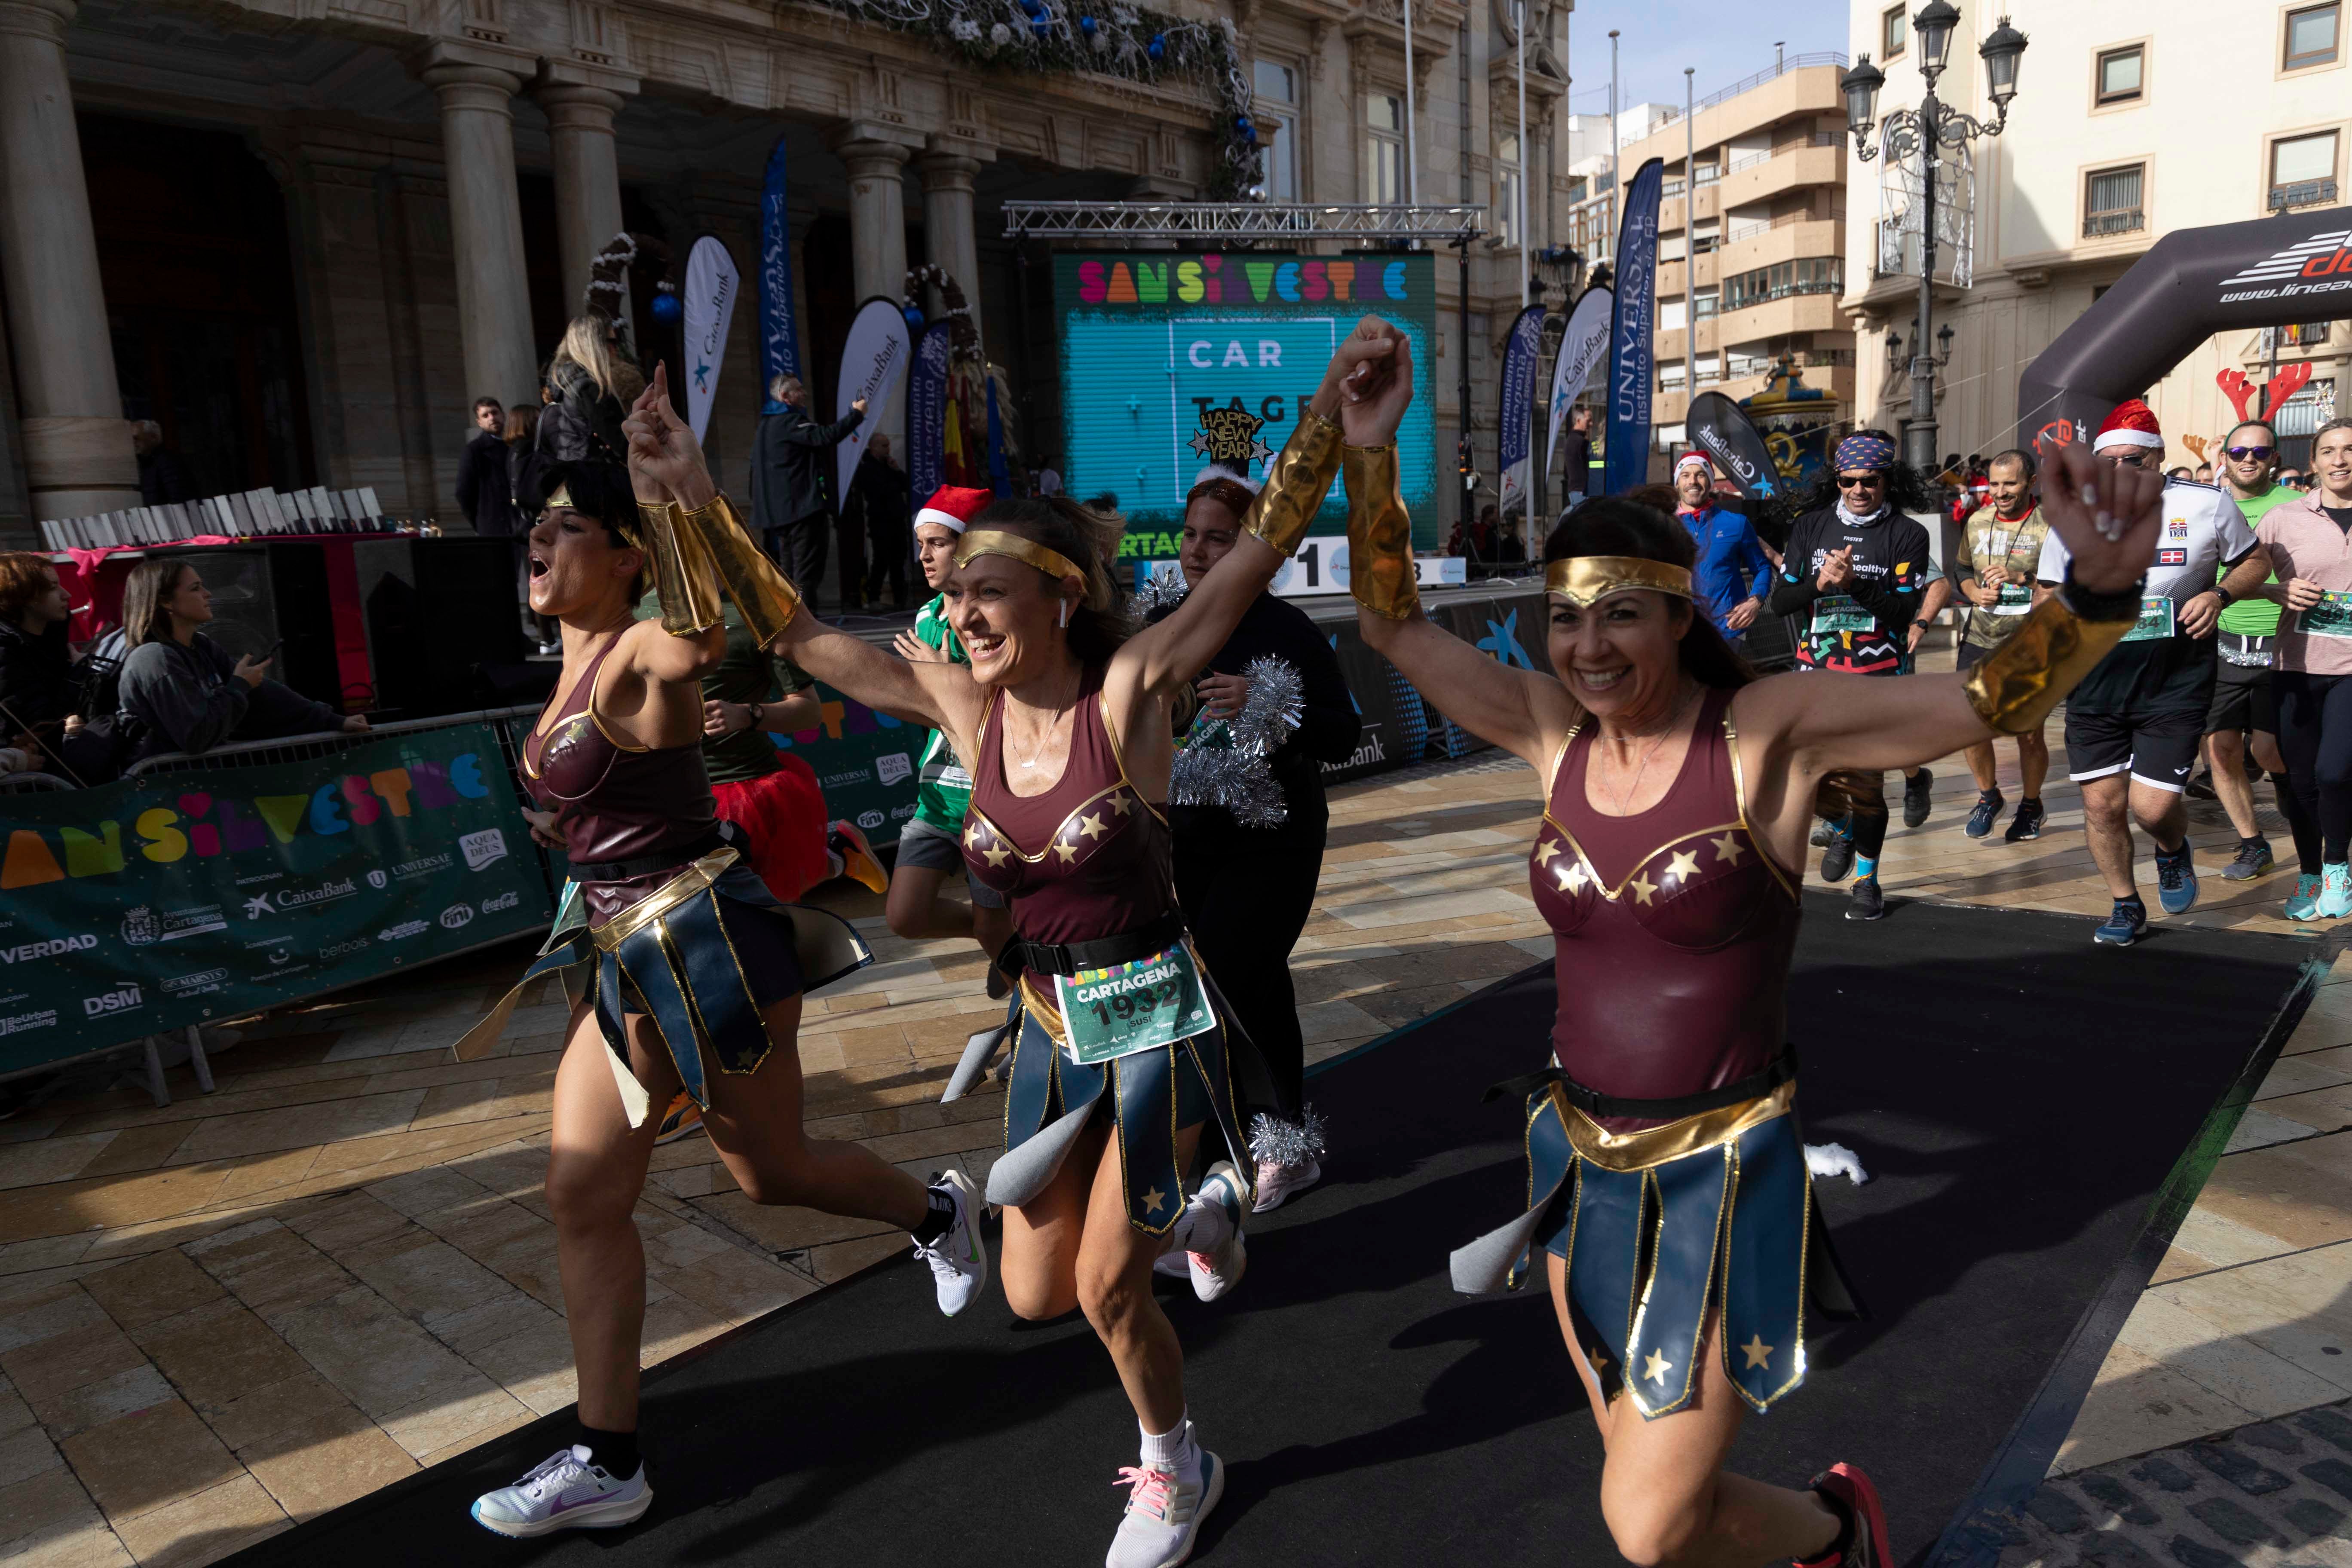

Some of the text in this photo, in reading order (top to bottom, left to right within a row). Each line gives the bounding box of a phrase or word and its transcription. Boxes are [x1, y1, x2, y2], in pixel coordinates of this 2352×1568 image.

[1644, 215, 1656, 239] FP
[2220, 280, 2352, 303] www.linea
[1636, 273, 1651, 348] Superior
[1188, 339, 1283, 368] CAR
[855, 334, 899, 402] CaixaBank
[1635, 353, 1648, 425] Instituto
[1501, 349, 1515, 457] Ayuntamiento
[1508, 354, 1527, 459] Cartagena
[1200, 410, 1263, 431] HAPPY
[911, 376, 922, 495] Ayuntamiento
[922, 379, 936, 496] Cartagena
[1209, 425, 1252, 443] NEW
[1297, 544, 1319, 586] 1
[1822, 606, 1867, 614] CARTAGENA
[881, 756, 907, 766] AQUA
[882, 764, 908, 775] DEUS
[466, 832, 499, 847] AQUA
[469, 844, 500, 857] DEUS
[391, 852, 452, 876] UNIVERSAE
[277, 876, 358, 906] CaixaBank
[162, 903, 222, 920] Ayuntamiento
[163, 912, 224, 930] Cartagena
[0, 934, 98, 964] VERDAD
[1077, 962, 1182, 1003] CARTAGENA
[83, 987, 142, 1015] DSM
[1092, 981, 1181, 1026] 1932
[7, 1009, 58, 1026] BeUrban
[7, 1015, 58, 1034] Running
[1130, 1015, 1152, 1027] SUSI
